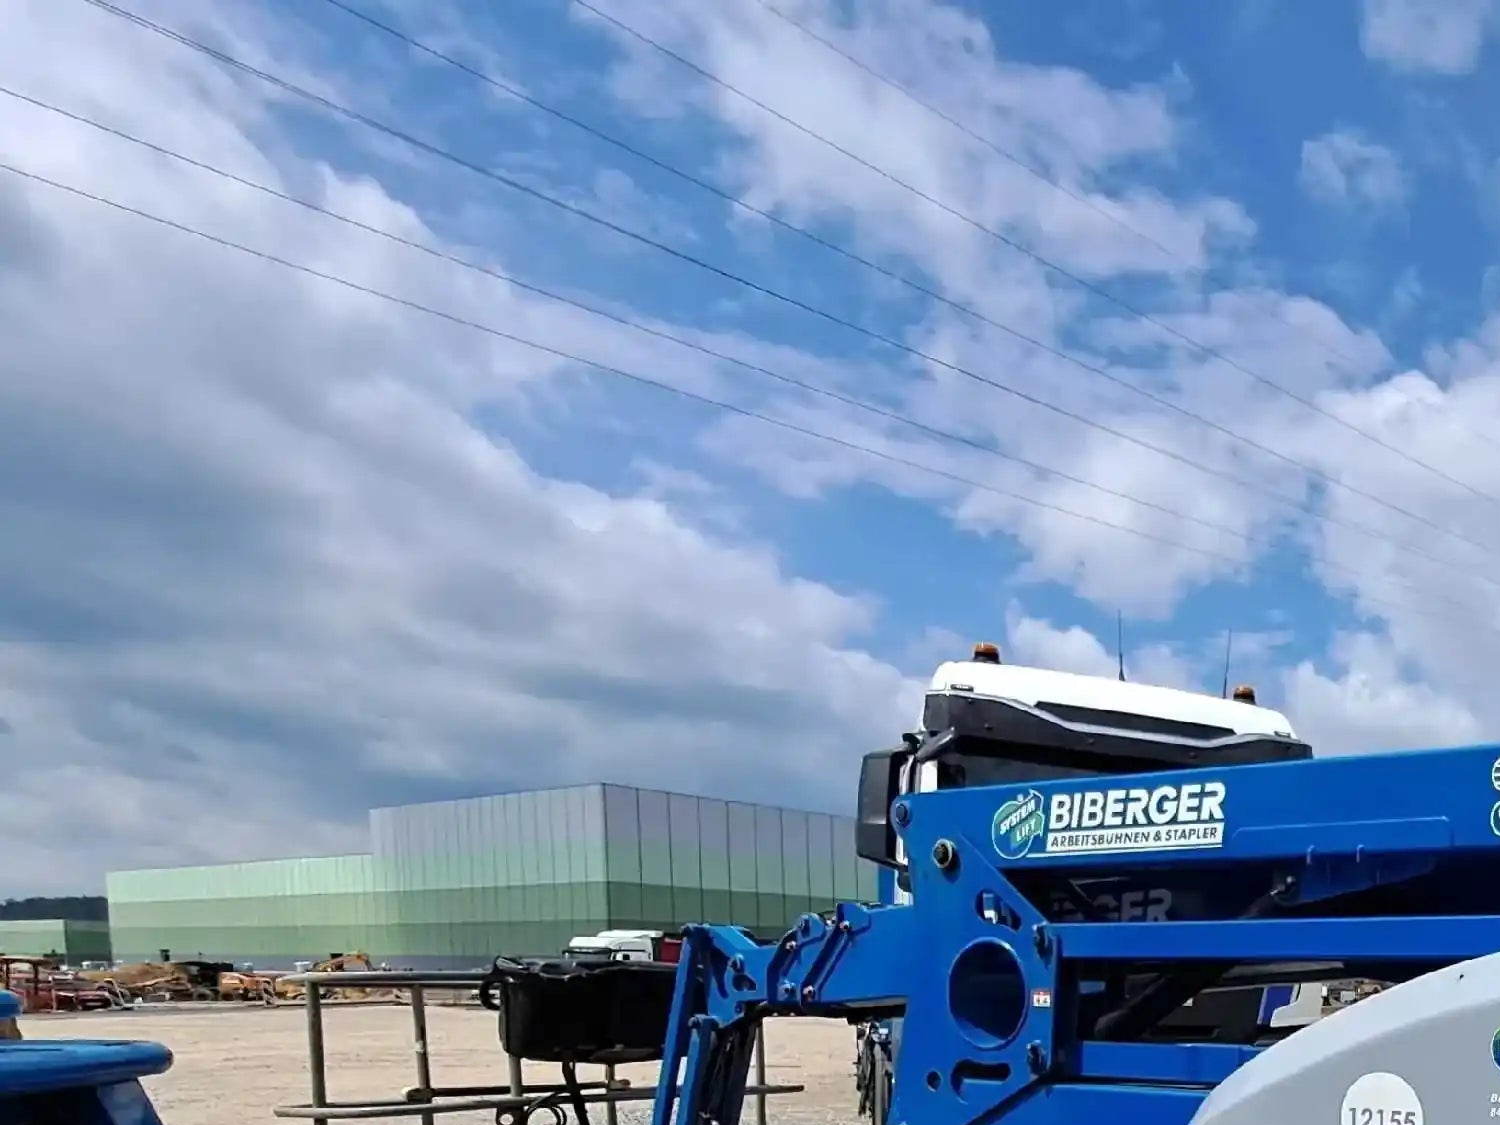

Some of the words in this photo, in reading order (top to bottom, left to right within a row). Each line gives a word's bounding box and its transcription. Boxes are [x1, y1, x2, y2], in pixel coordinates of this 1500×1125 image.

[1000, 799, 1035, 835] SYSTEM
[1049, 782, 1226, 829] BIBERGER
[1017, 818, 1036, 842] LIFT
[1153, 831, 1162, 842] &
[1165, 827, 1218, 842] STAPLER
